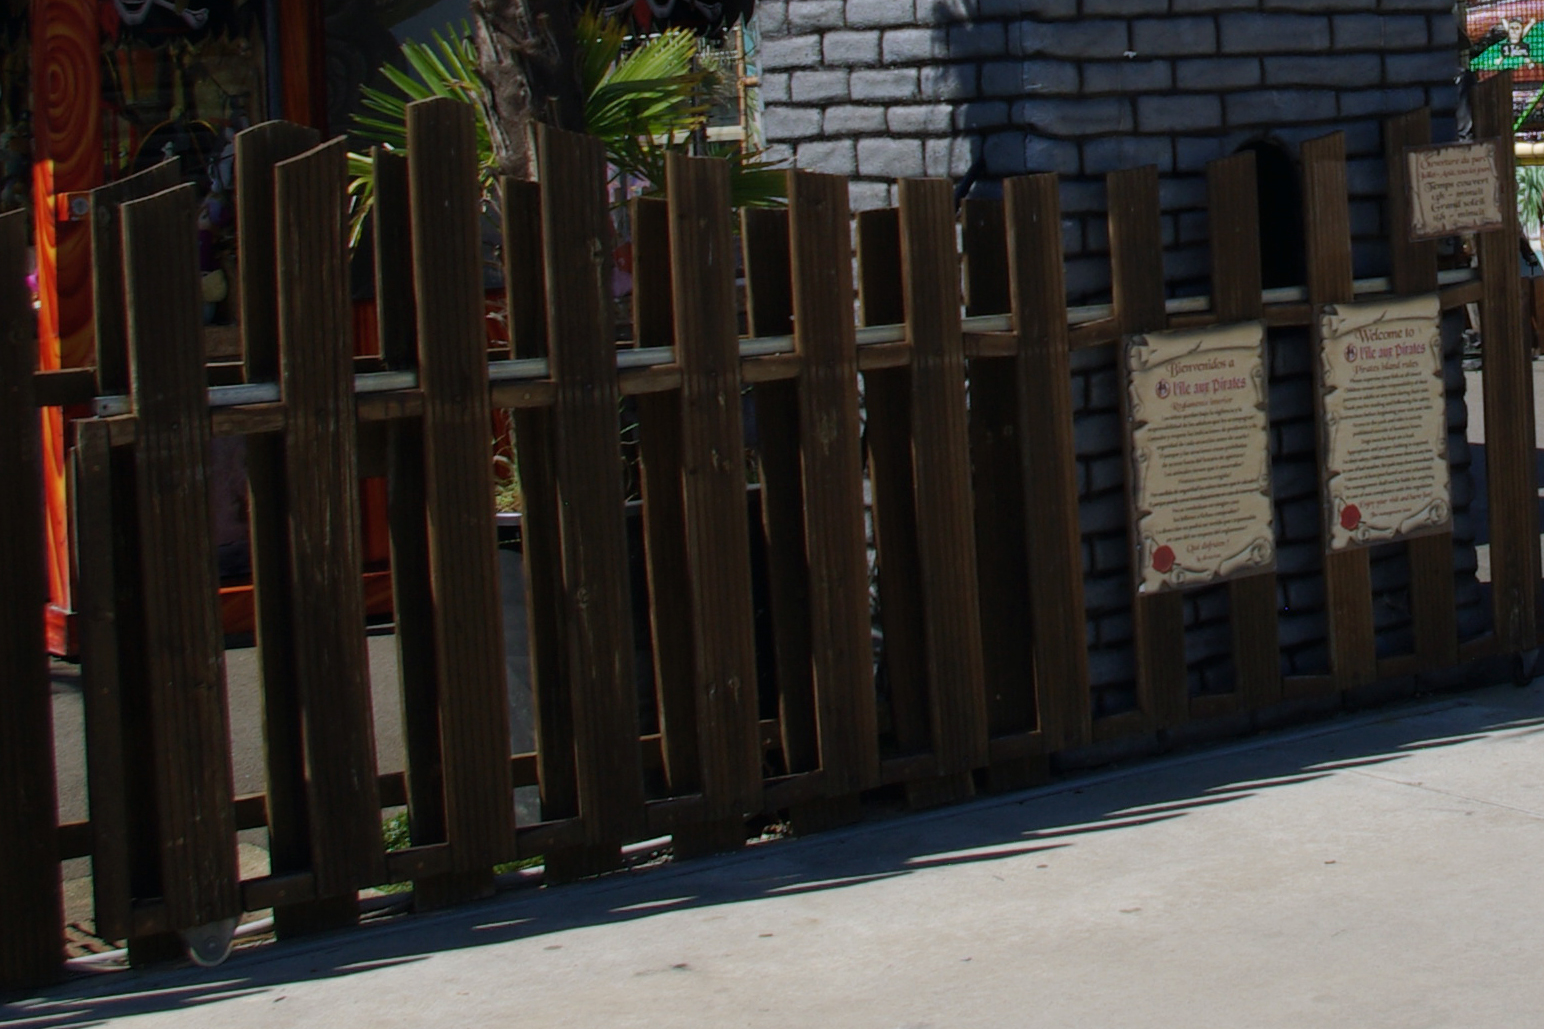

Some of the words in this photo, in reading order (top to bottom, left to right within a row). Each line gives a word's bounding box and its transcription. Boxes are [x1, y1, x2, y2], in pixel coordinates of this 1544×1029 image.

[1424, 181, 1454, 192] Temps
[1456, 177, 1489, 187] couvert
[1354, 327, 1402, 342] Welcome
[1405, 327, 1415, 337] to
[1395, 341, 1426, 359] Pirates
[1165, 356, 1226, 377] Bienvenidos
[1228, 359, 1235, 368] a
[1211, 375, 1246, 394] Pirates
